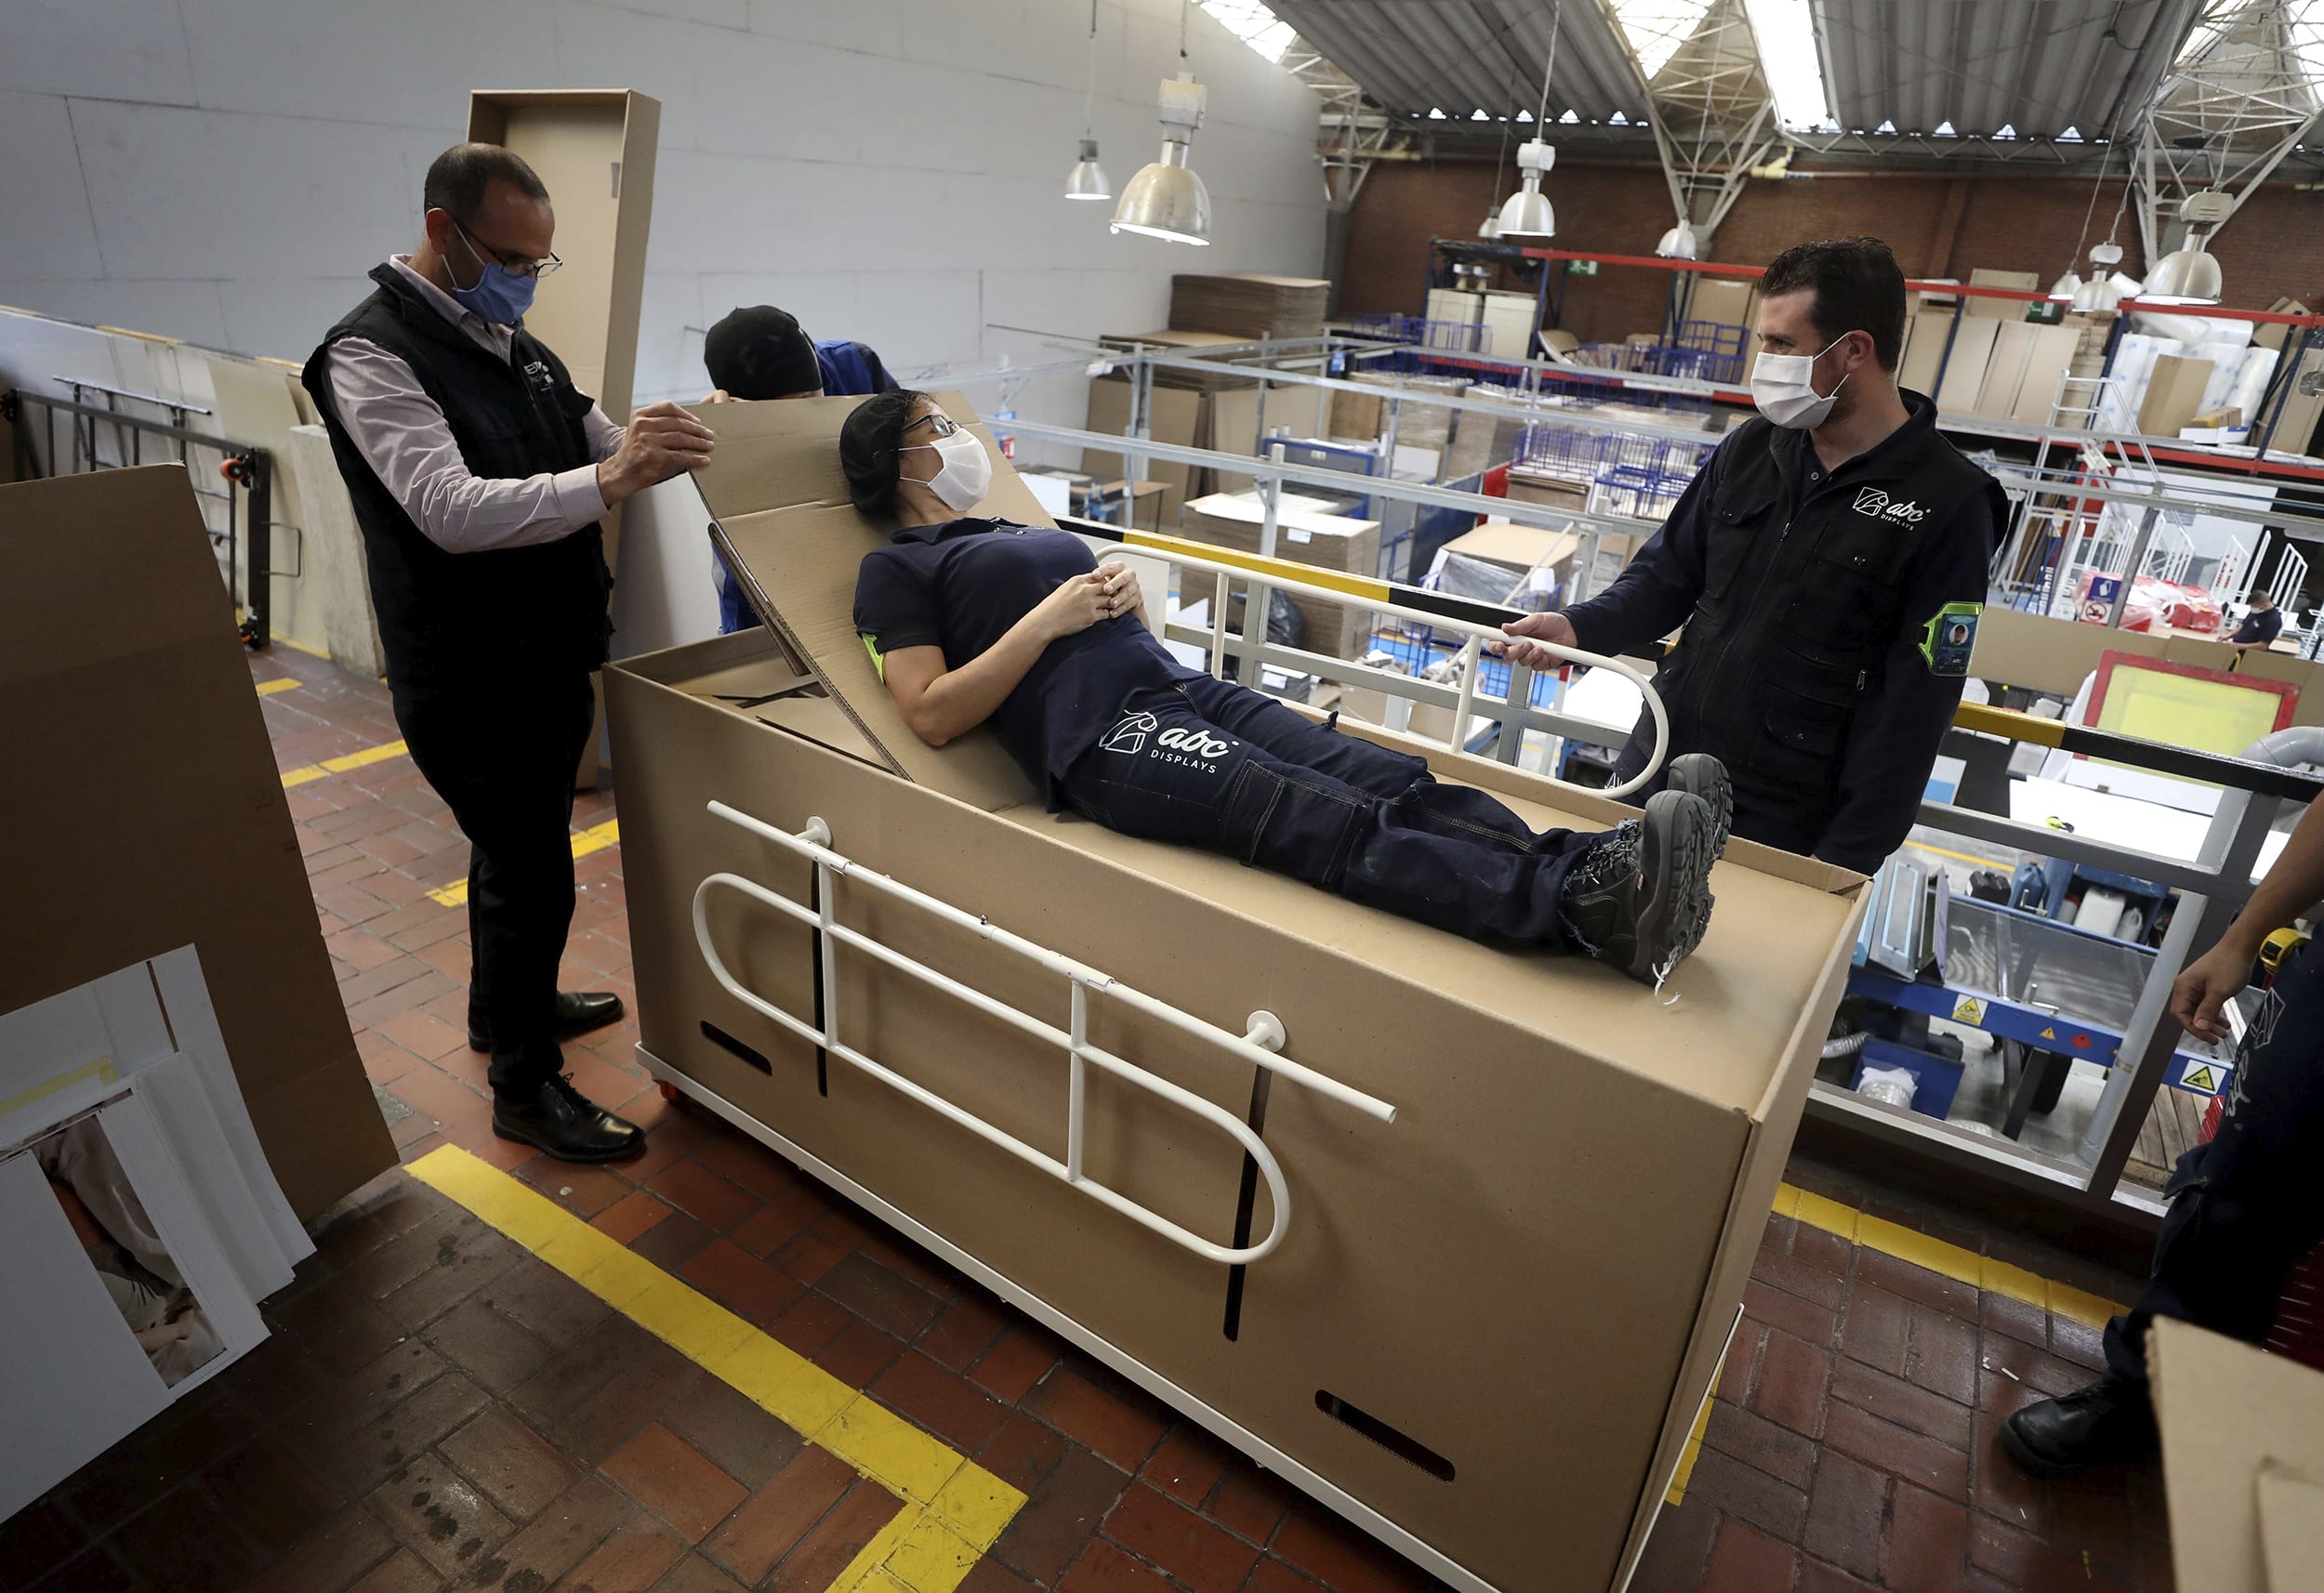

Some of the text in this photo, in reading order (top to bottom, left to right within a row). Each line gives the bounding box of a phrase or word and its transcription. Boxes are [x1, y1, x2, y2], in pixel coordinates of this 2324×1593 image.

[1880, 513, 1915, 531] DISPLAYS
[1885, 501, 1924, 522] abc
[1157, 728, 1229, 758] abc
[1150, 749, 1218, 774] DISPLAYS
